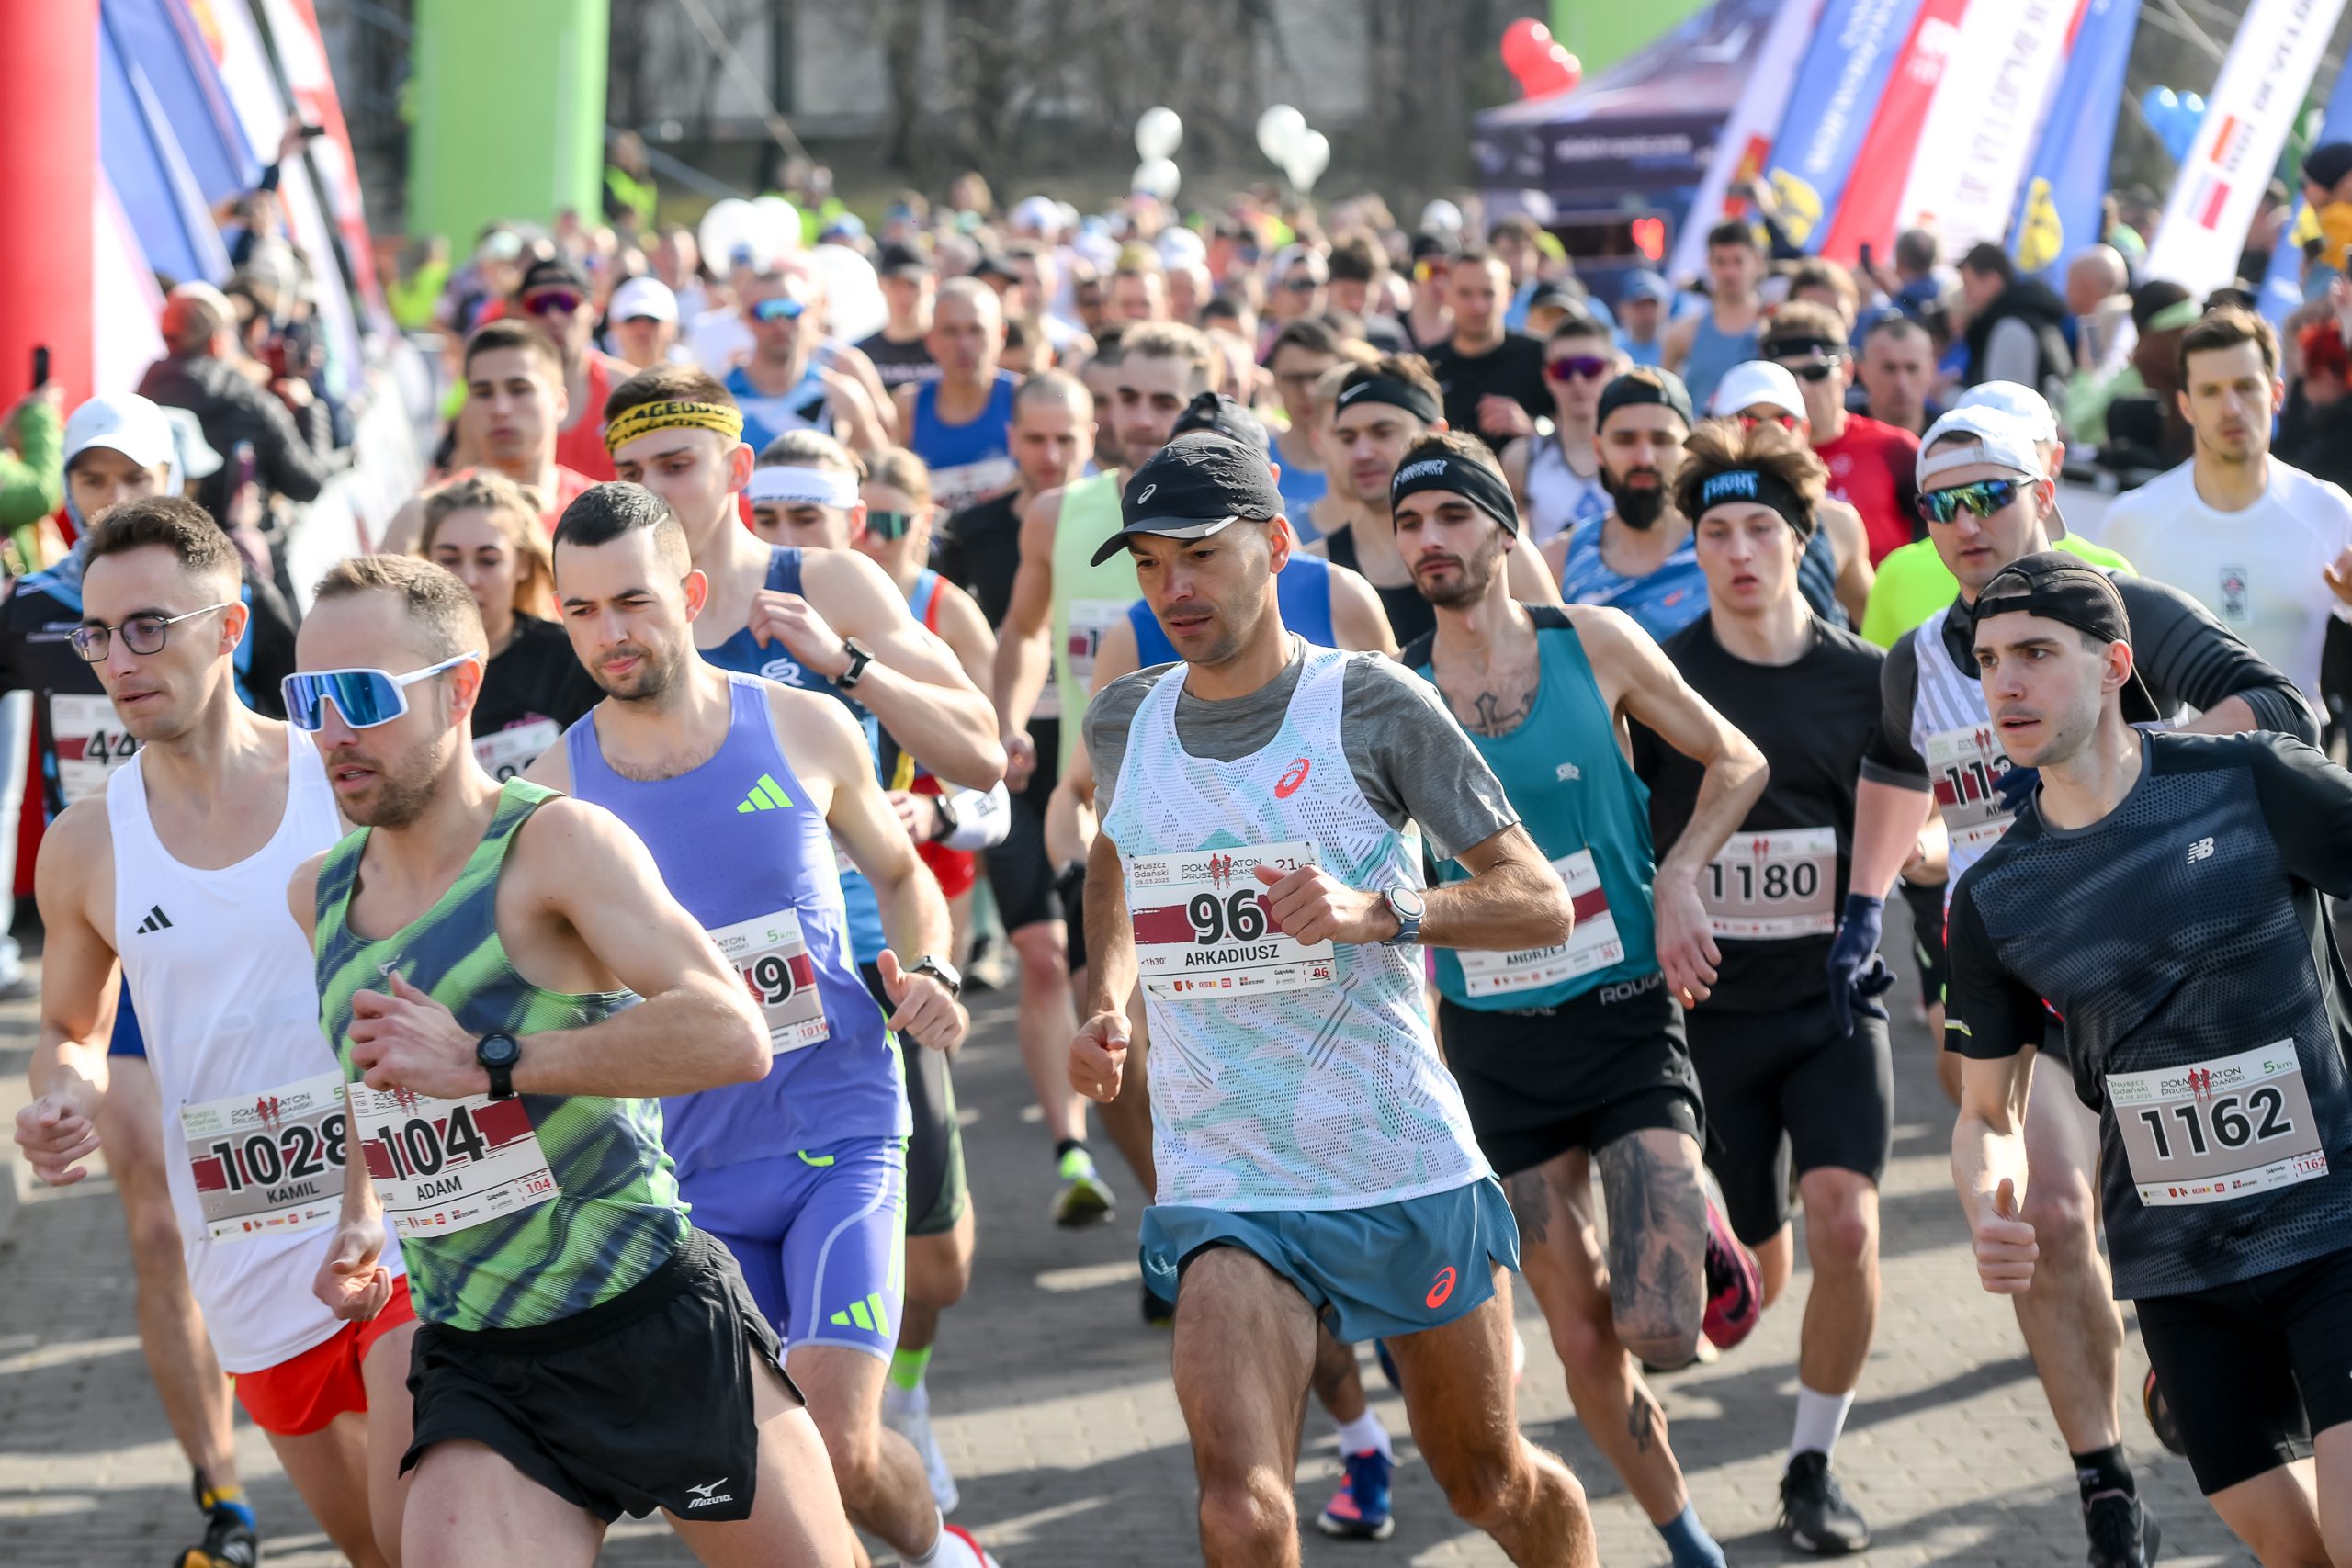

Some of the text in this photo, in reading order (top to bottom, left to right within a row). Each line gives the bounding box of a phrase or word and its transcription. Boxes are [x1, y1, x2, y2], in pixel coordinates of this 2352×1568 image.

[1275, 857, 1297, 871] 21
[1708, 862, 1817, 899] 1180
[1189, 889, 1265, 945] 96
[766, 929, 779, 942] 5
[1184, 944, 1280, 967] ARKADIUSZ
[1313, 967, 1329, 978] 96
[2263, 1058, 2293, 1074] 5 km
[333, 1086, 345, 1100] 5
[2140, 1088, 2292, 1158] 1162
[210, 1113, 346, 1192] 1028
[377, 1105, 486, 1181] 104
[2299, 1156, 2326, 1173] 1162
[266, 1181, 321, 1204] KAMIL
[416, 1175, 464, 1201] ADAM
[526, 1178, 552, 1194] 104
